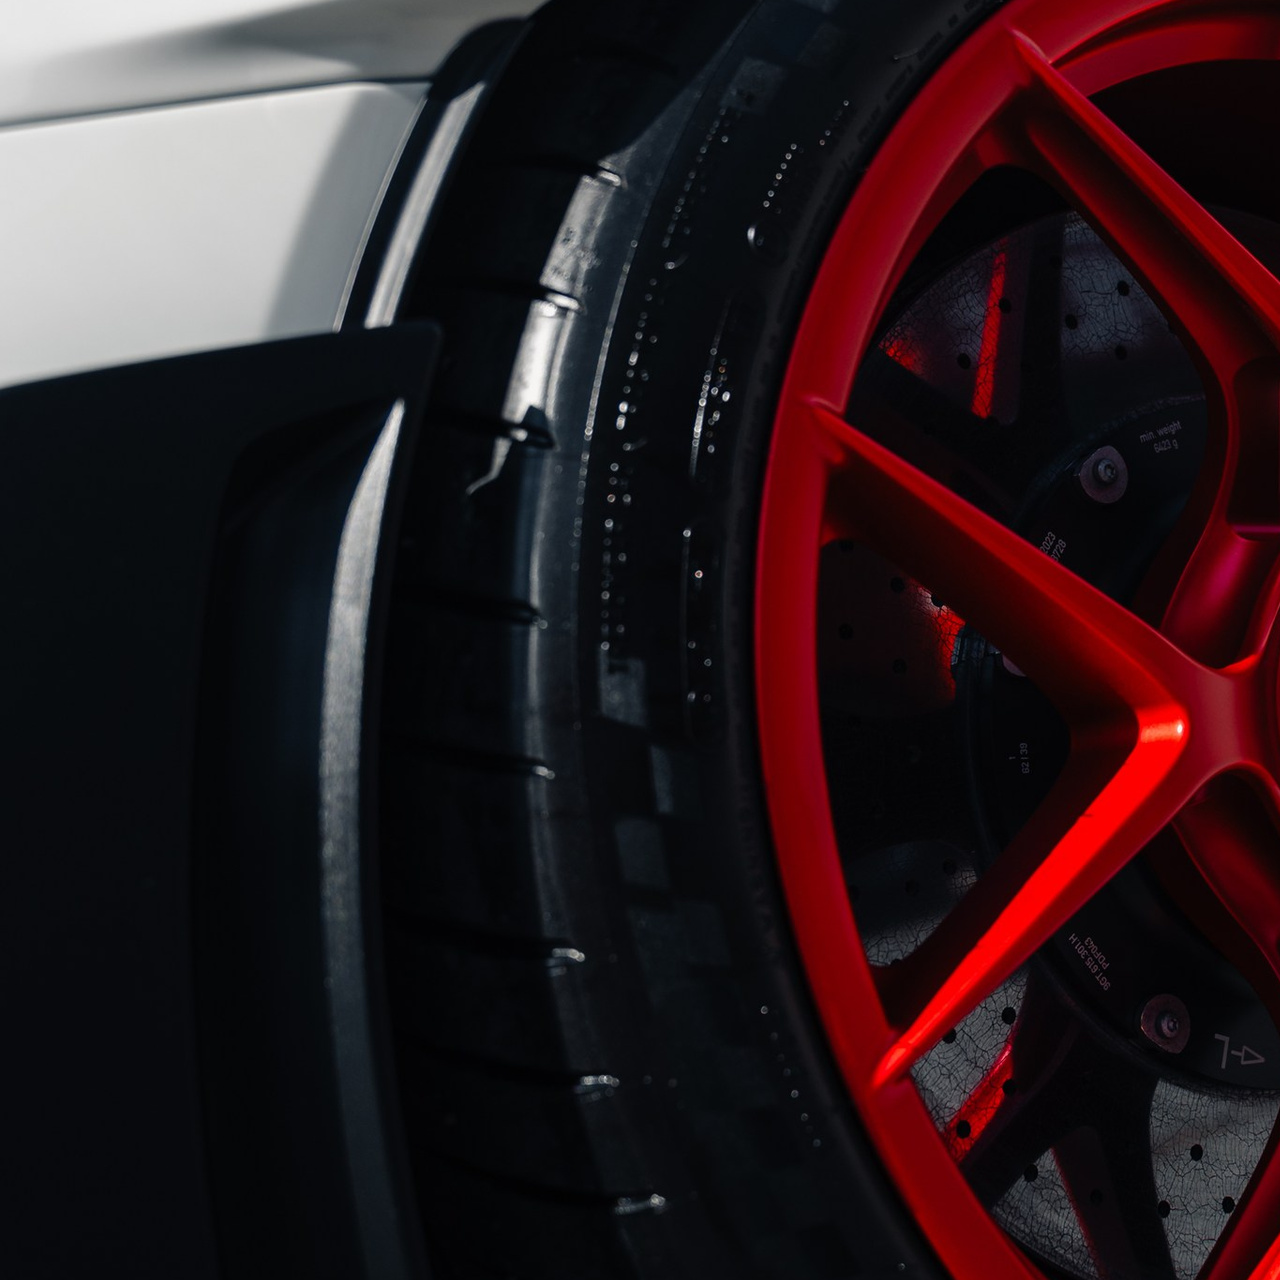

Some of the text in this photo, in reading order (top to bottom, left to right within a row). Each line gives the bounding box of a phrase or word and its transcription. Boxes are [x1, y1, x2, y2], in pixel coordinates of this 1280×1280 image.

[1138, 420, 1182, 443] min. weight
[1152, 439, 1172, 453] 6423
[1067, 931, 1112, 991] 9GT.615.301.H
[1083, 936, 1110, 970] PDF043
